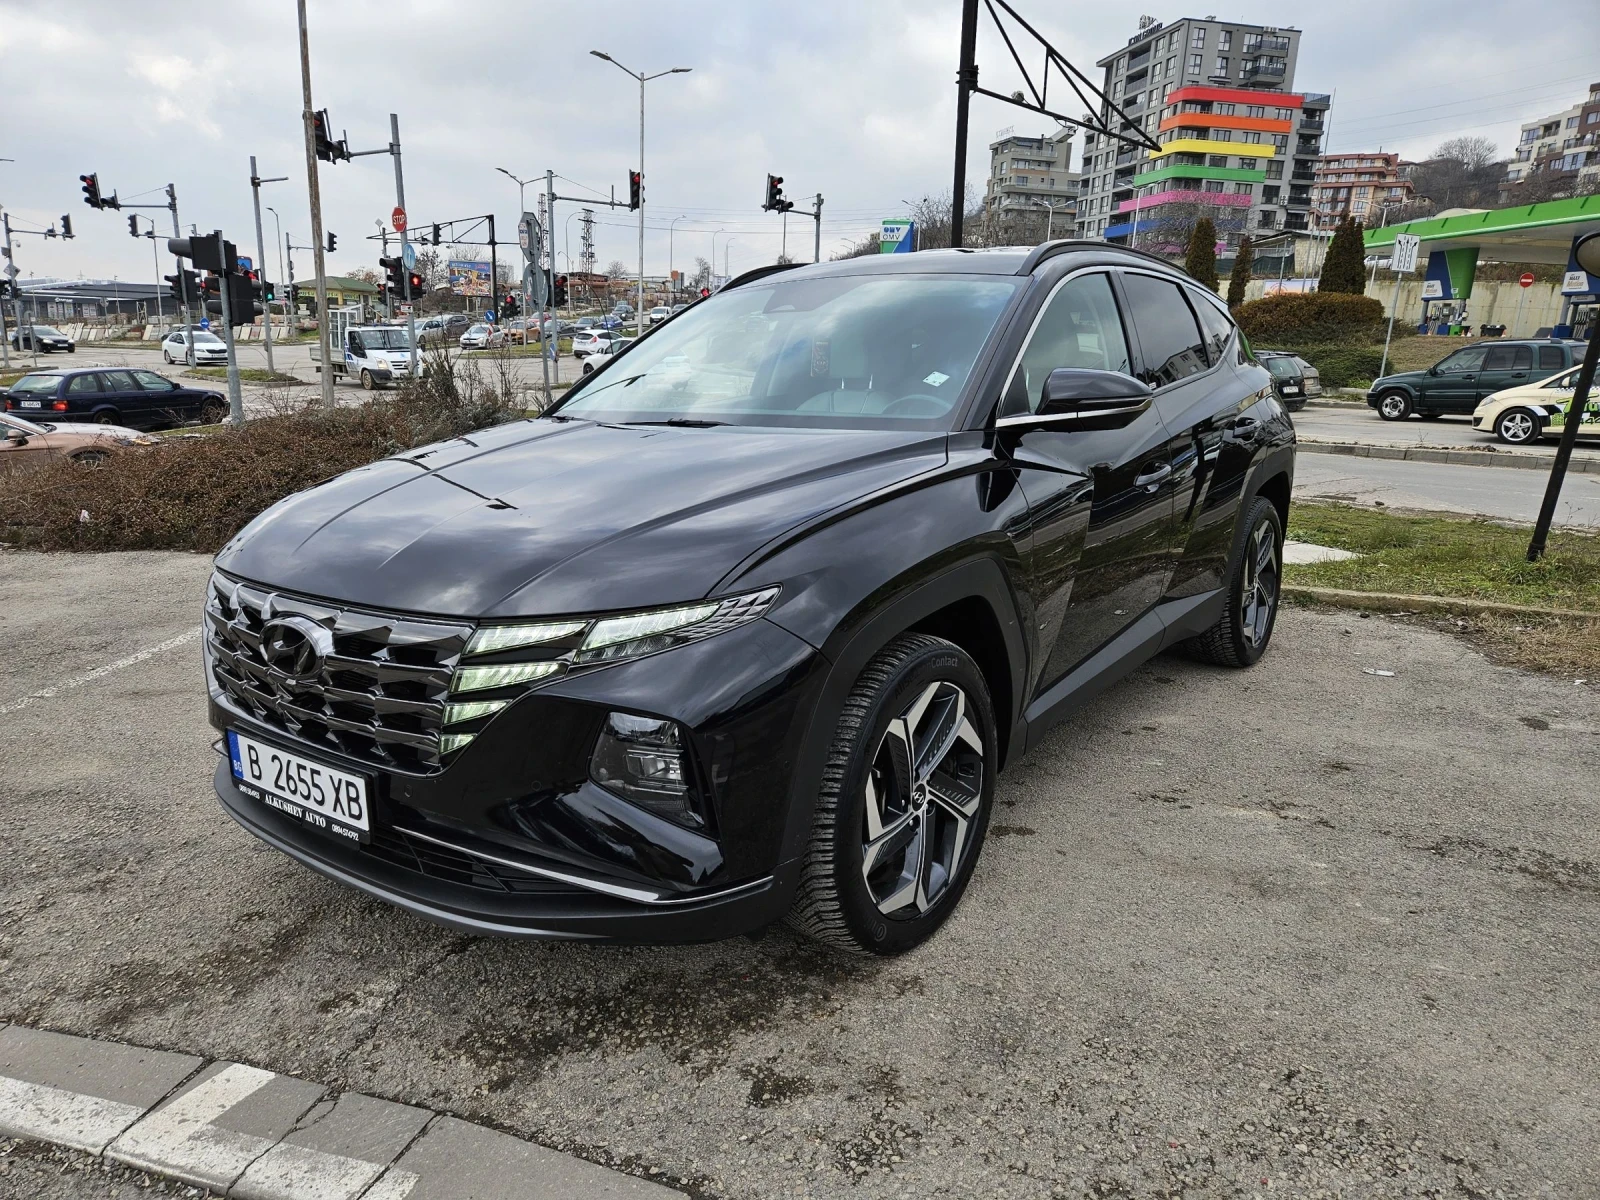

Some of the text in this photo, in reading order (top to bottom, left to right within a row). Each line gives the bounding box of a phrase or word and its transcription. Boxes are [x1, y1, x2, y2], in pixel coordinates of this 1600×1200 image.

[393, 214, 406, 225] STOP
[882, 233, 901, 241] OMV
[233, 759, 242, 772] BG
[247, 743, 363, 821] B 2655 XB
[264, 793, 303, 819] ALKUSHEV
[304, 810, 327, 828] AUTO
